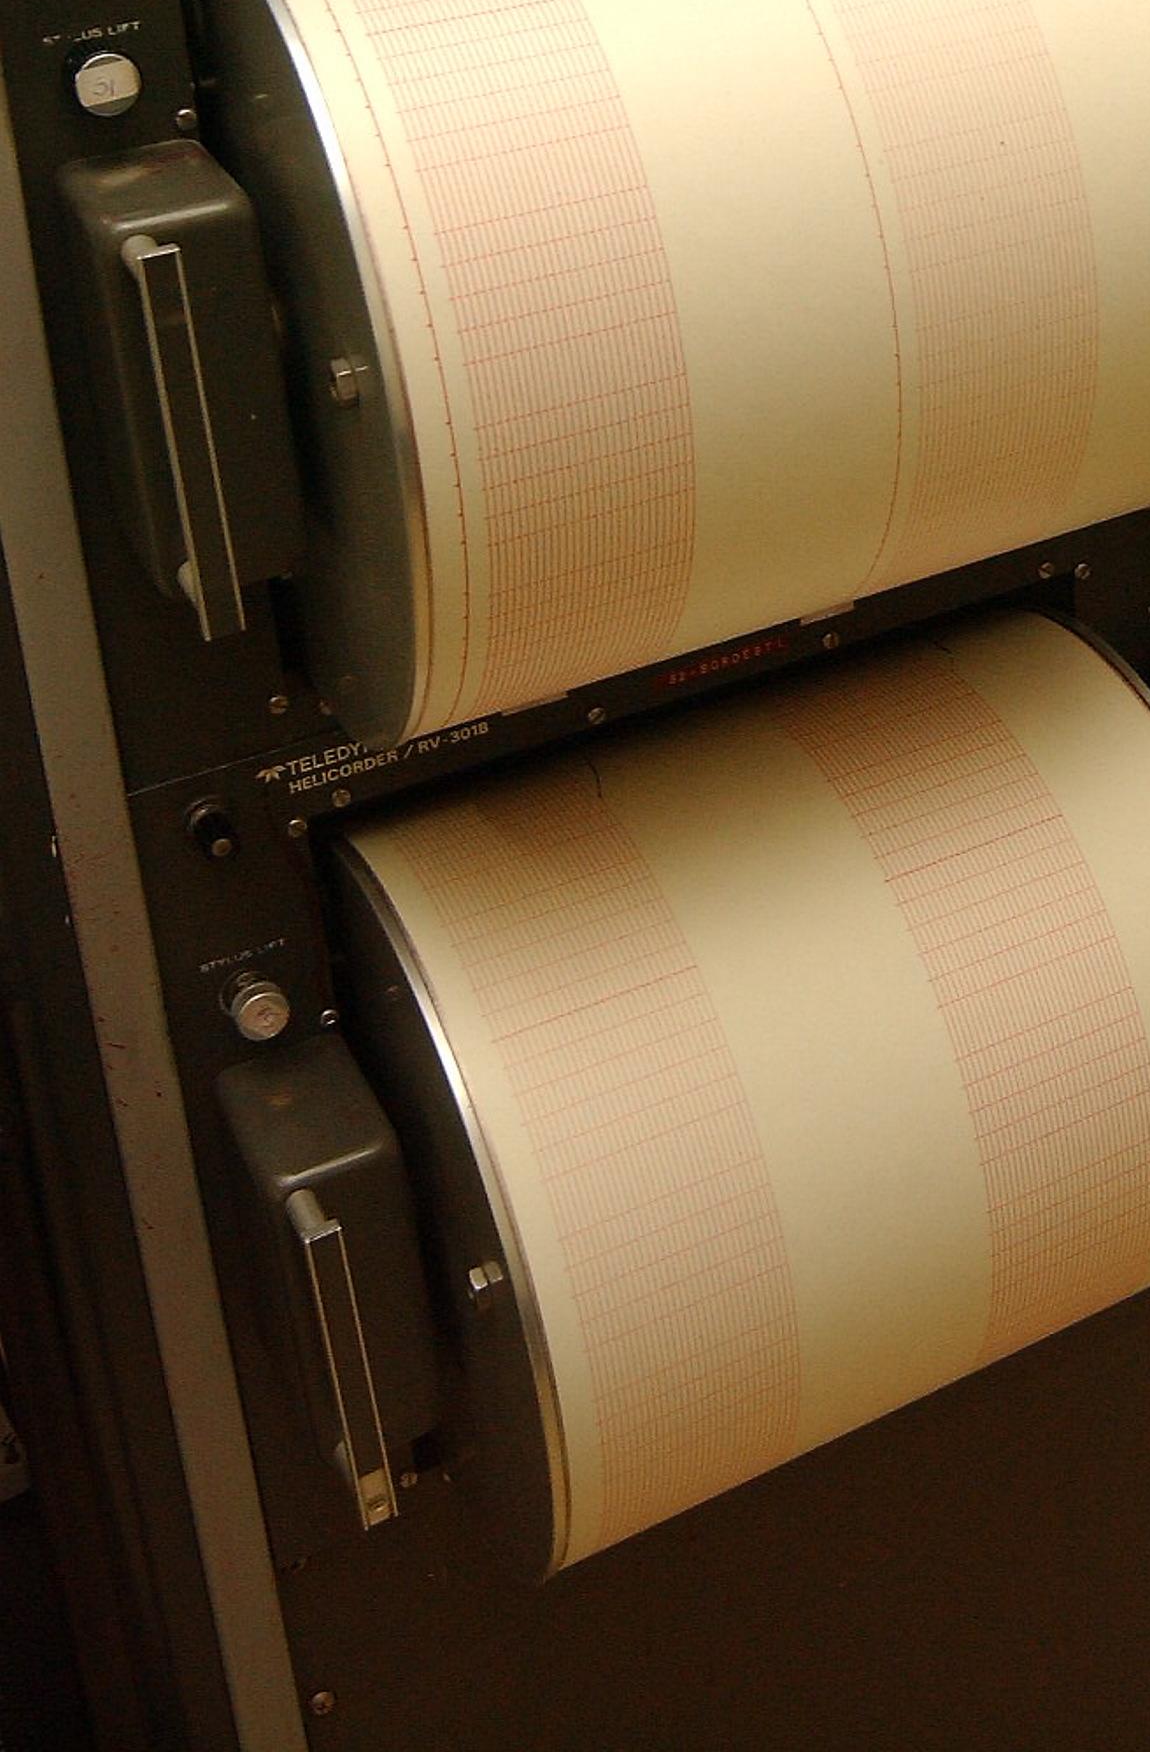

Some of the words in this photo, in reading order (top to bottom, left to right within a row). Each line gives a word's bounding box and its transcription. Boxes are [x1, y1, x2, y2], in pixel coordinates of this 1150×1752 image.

[285, 741, 368, 775] TELEDY
[288, 748, 399, 794] HELICORDER
[418, 720, 490, 755] RV-301B
